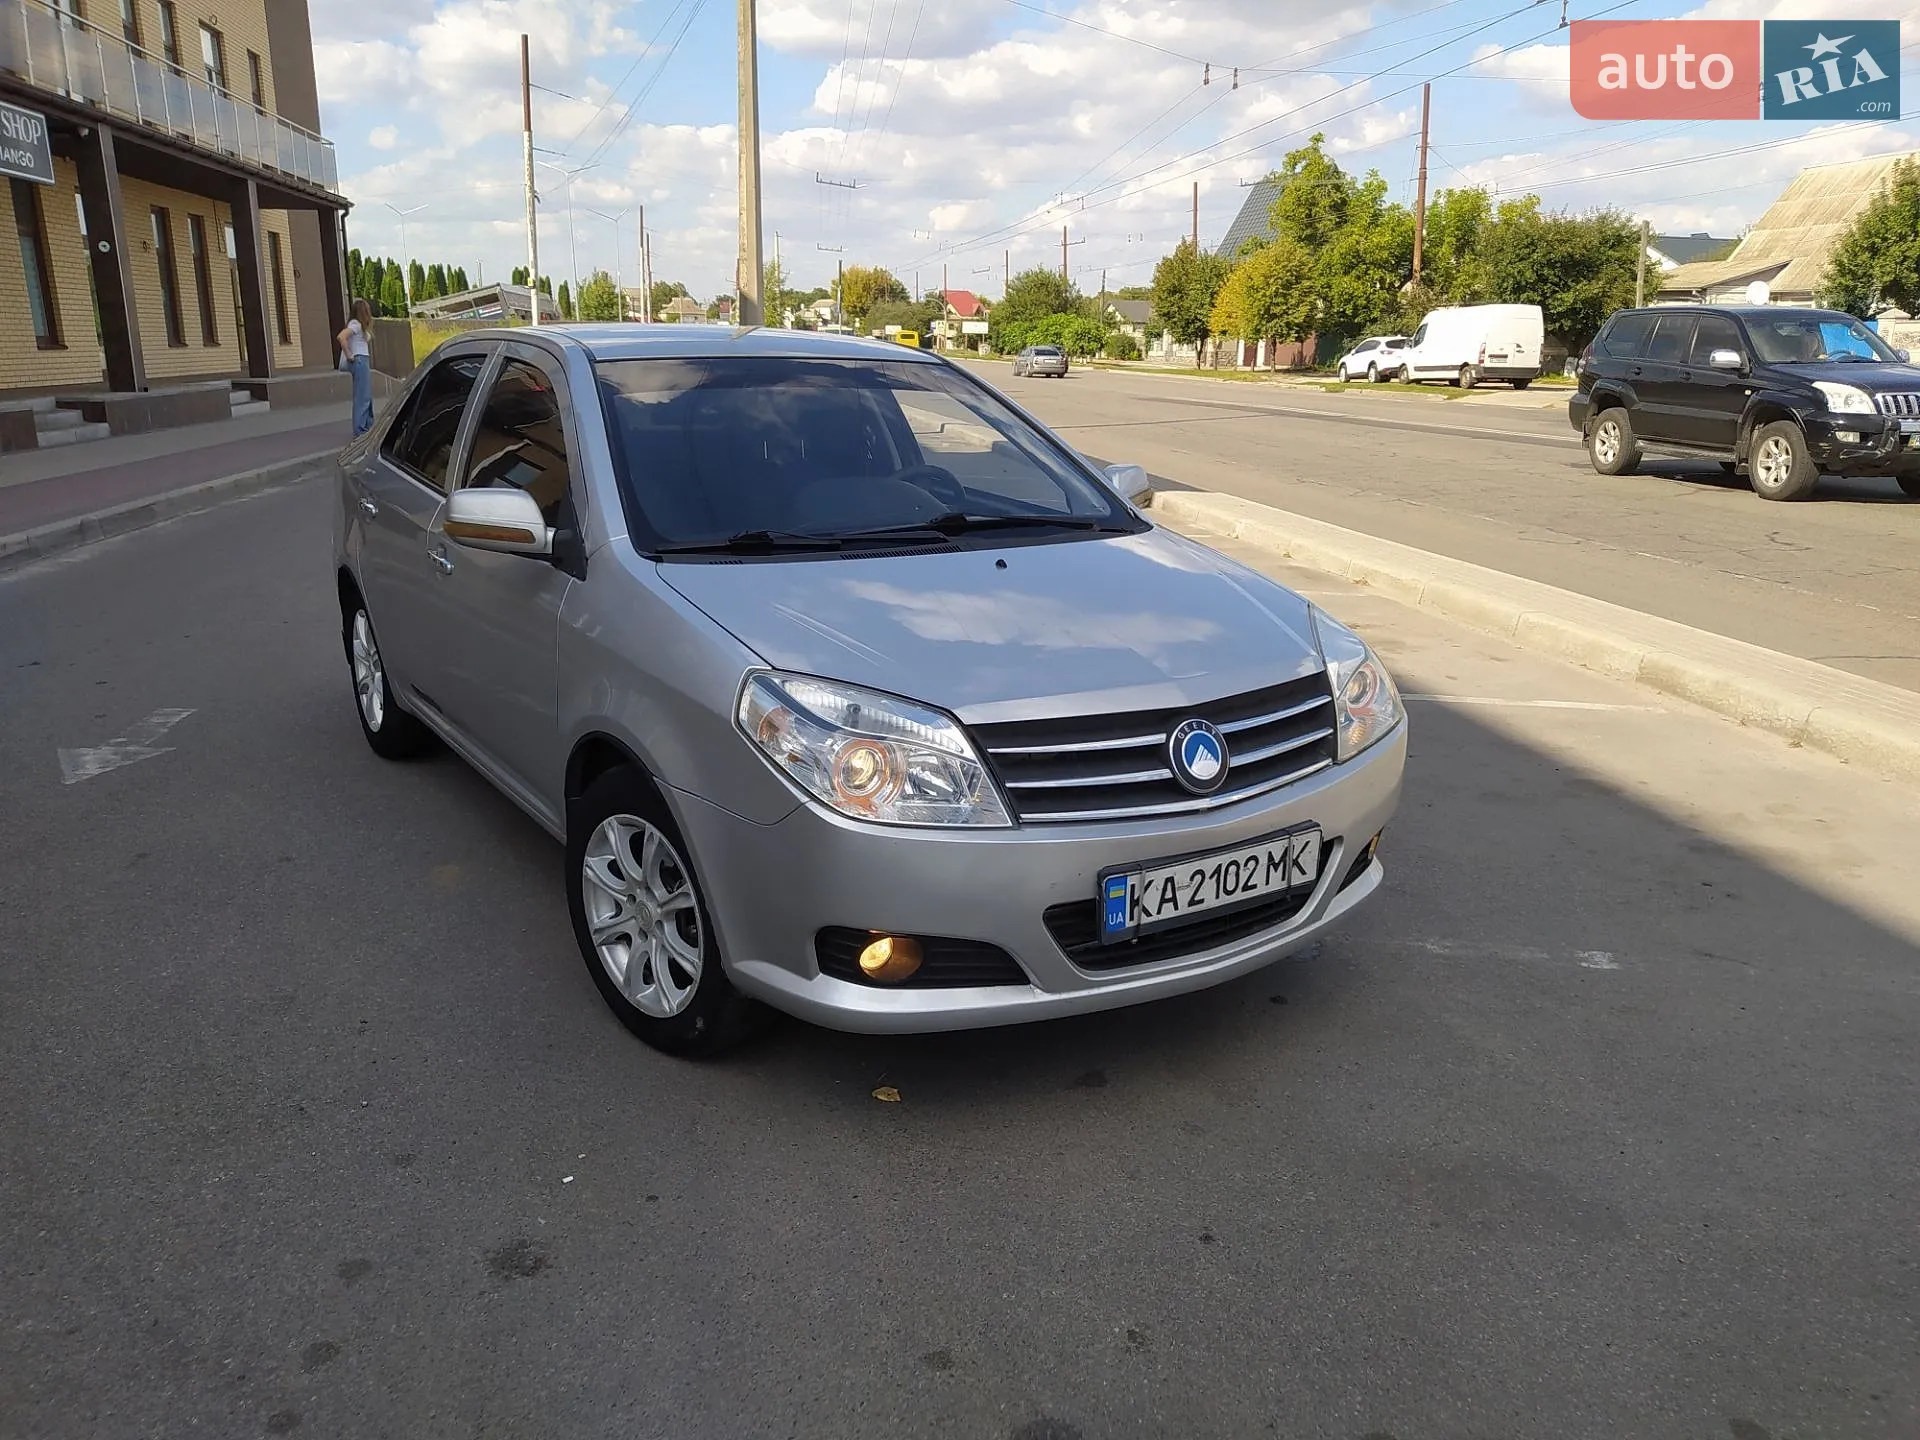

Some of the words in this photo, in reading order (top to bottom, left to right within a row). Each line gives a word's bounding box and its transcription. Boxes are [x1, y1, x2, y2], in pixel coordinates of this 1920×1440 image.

[0, 110, 41, 145] SHOP
[0, 145, 35, 168] ANGO
[1177, 721, 1217, 739] GEELY
[1108, 911, 1125, 926] UA
